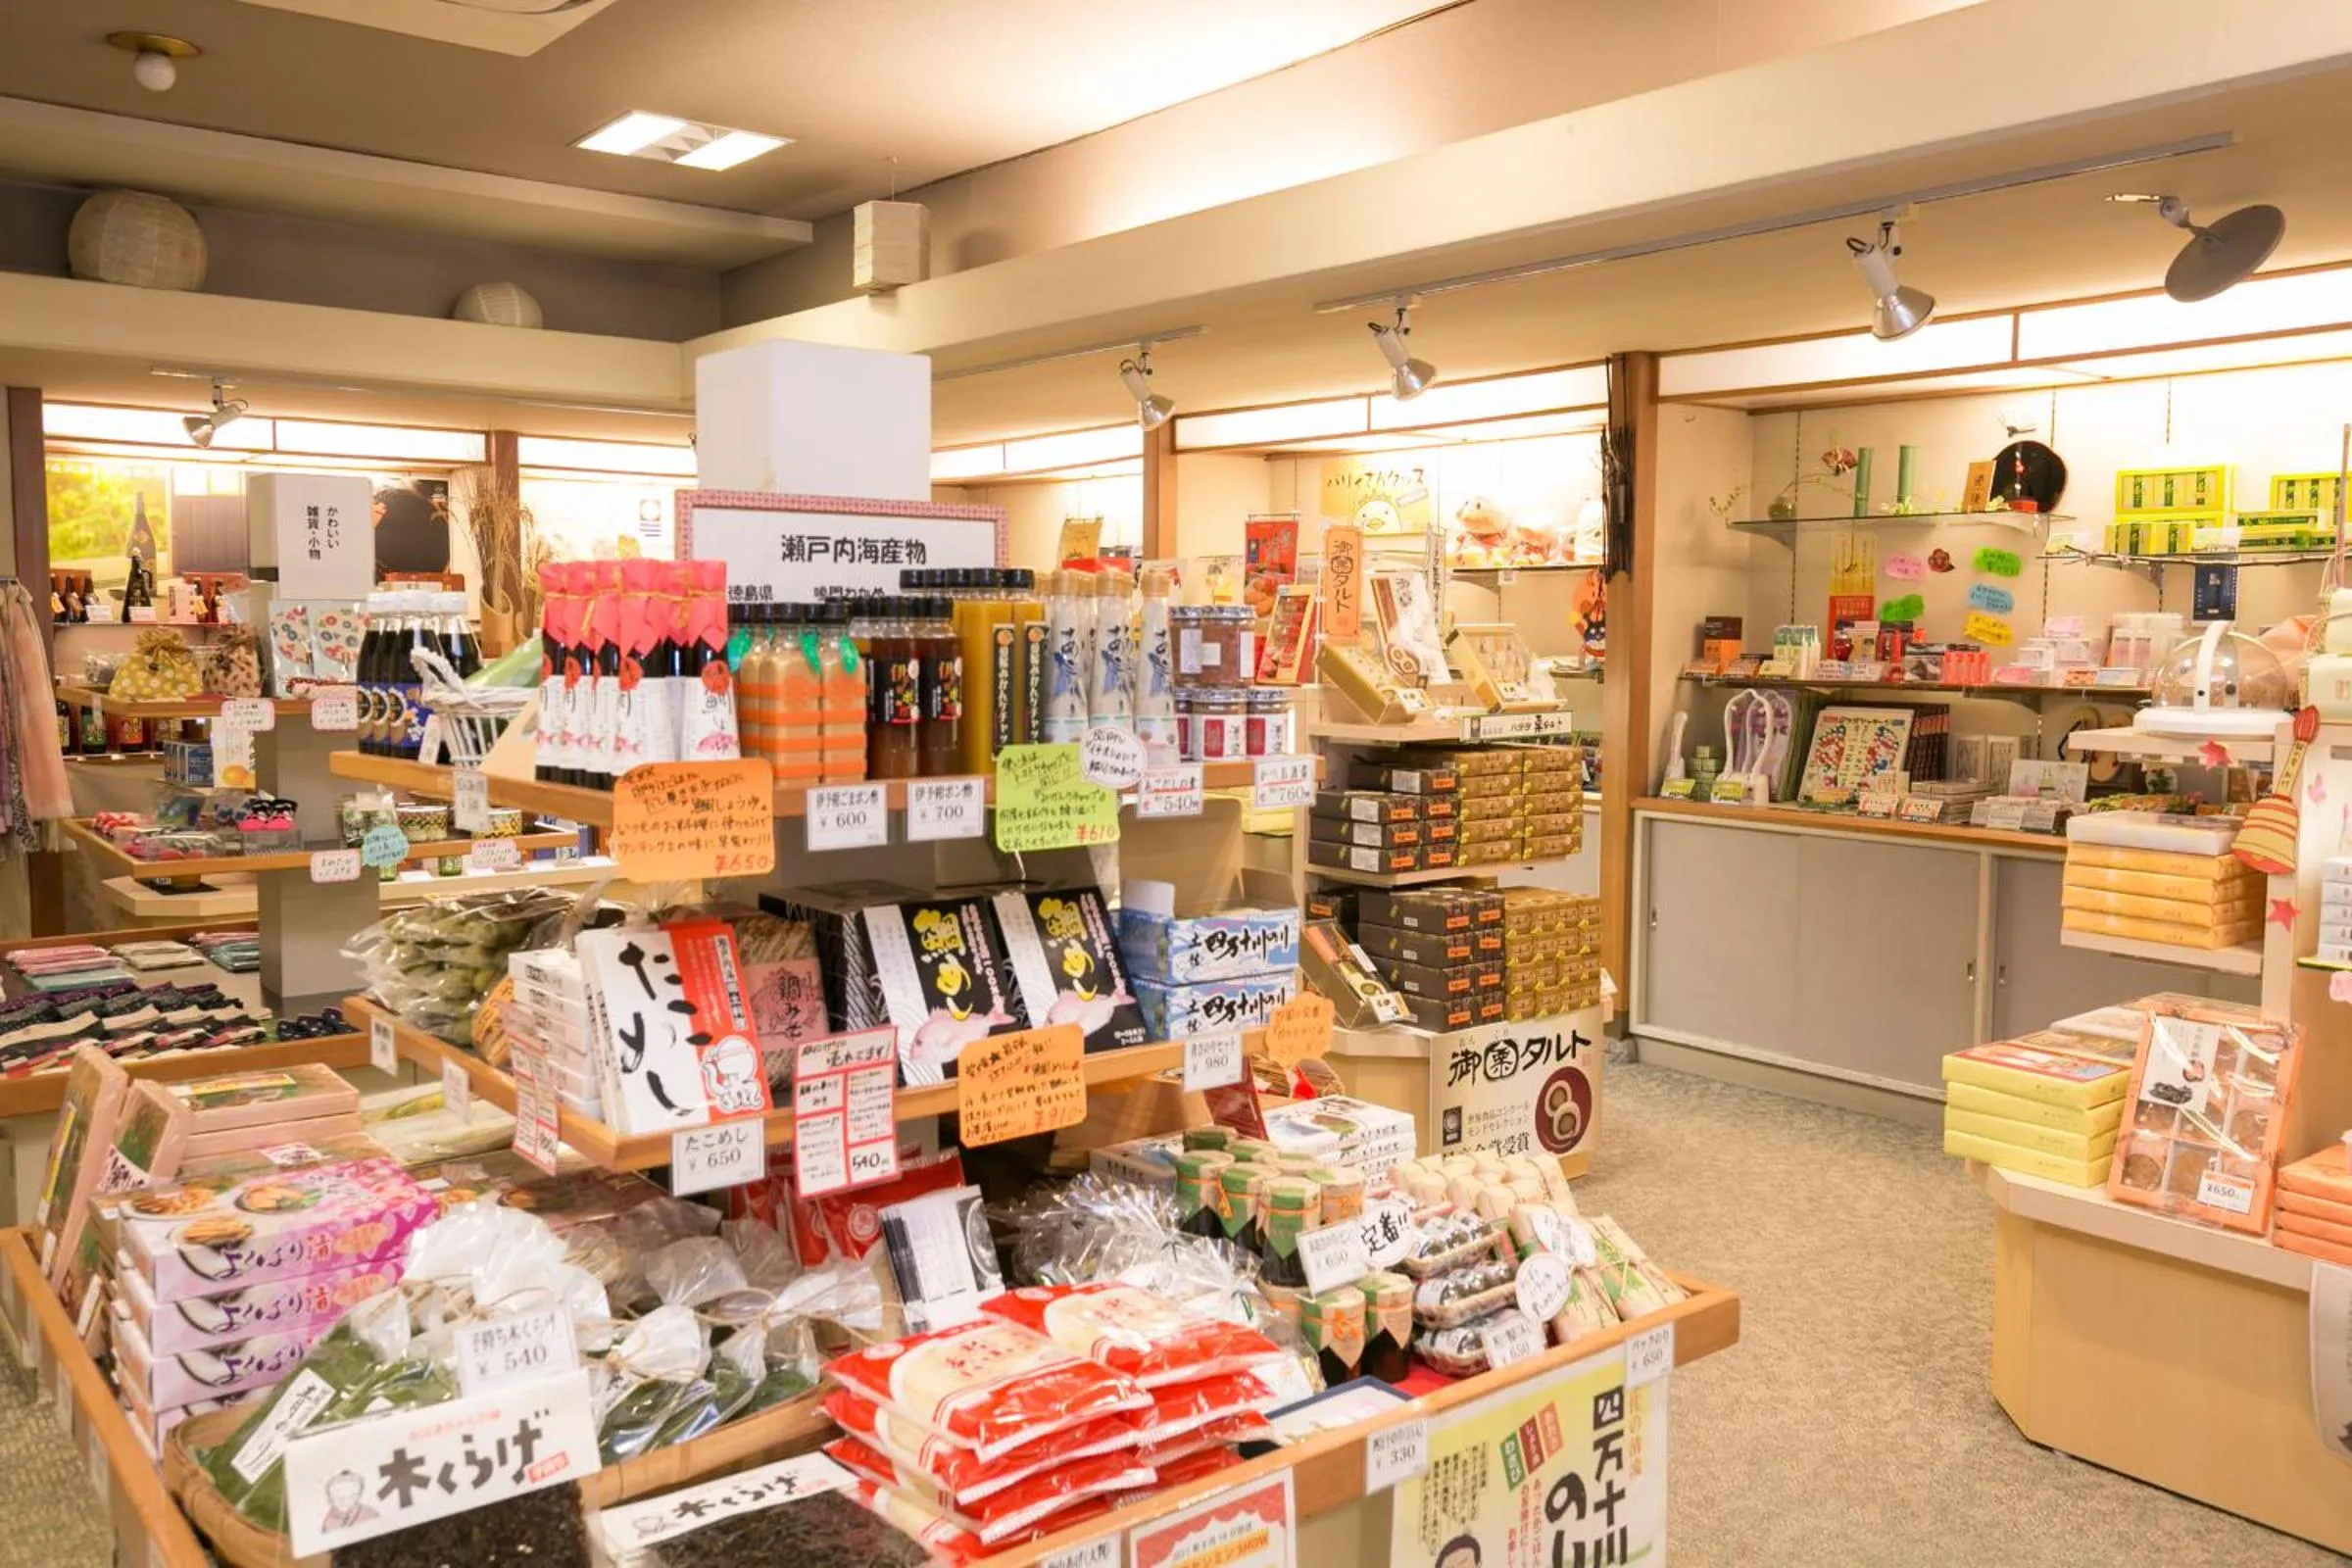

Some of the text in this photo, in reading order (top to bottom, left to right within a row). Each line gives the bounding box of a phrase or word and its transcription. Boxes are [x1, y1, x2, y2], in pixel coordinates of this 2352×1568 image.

[307, 506, 321, 561] 雑貨・小物
[326, 506, 339, 549] かわいい
[781, 534, 927, 565] 瀬戸内海産物
[836, 811, 867, 828] 600
[936, 805, 964, 820] 700
[1204, 924, 1289, 961] 四万十川のり
[1205, 1054, 1229, 1071] 980
[1447, 1029, 1592, 1088] 御栗タルト
[685, 1128, 749, 1152] たこめし
[708, 1147, 741, 1167] 650
[1360, 1209, 1410, 1258] 定番!!
[503, 1344, 548, 1371] 540
[376, 1407, 552, 1509] 木くらげ
[1391, 1444, 1416, 1465] 330
[673, 1469, 801, 1522] 木くらげ
